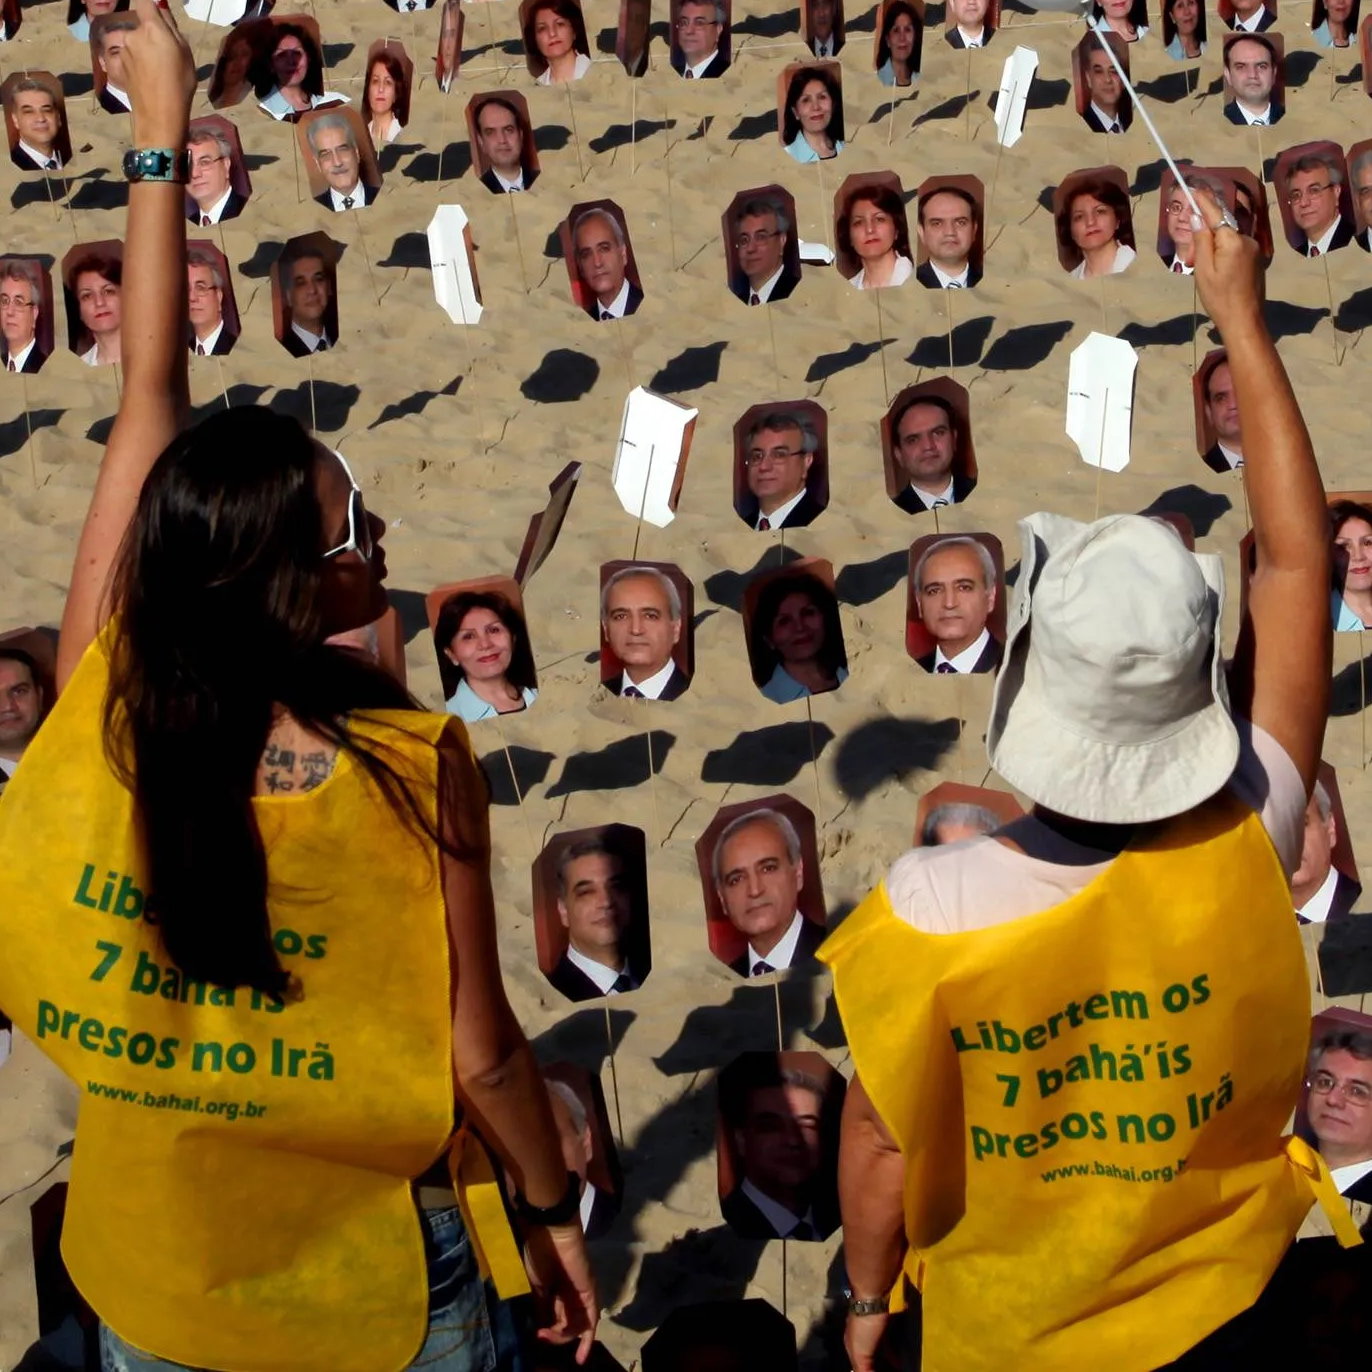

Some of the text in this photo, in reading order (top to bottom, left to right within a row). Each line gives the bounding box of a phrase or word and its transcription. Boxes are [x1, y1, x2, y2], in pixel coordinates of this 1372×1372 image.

[73, 863, 327, 959] Libe os
[89, 939, 123, 982] 7
[37, 999, 335, 1081] presos no Irã
[950, 974, 1211, 1054] Libertem os
[87, 1080, 267, 1121] www.bahai.org.br
[970, 1072, 1234, 1161] presos no Irã
[996, 1073, 1021, 1107] 7
